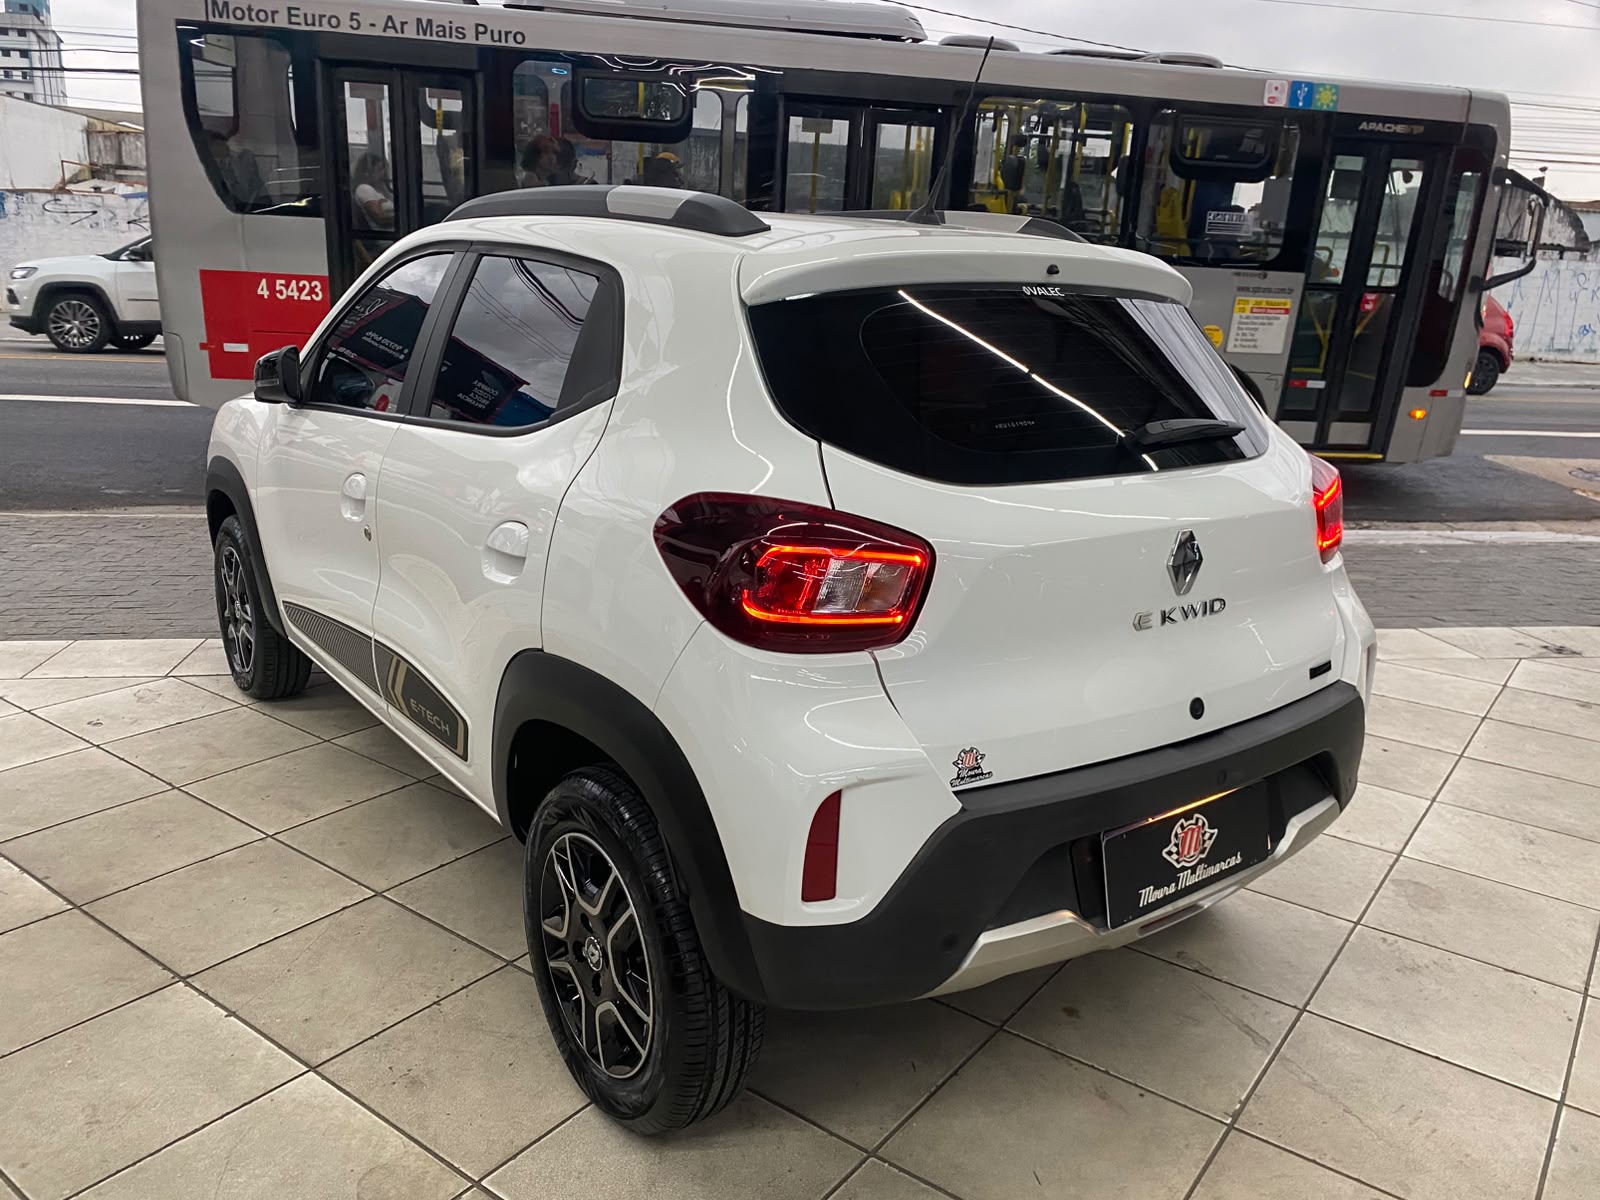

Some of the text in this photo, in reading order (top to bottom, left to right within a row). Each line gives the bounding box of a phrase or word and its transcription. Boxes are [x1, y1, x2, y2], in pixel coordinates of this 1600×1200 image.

[211, 0, 279, 24] Motor
[286, 6, 341, 29] Euro
[349, 12, 361, 31] 5
[382, 14, 408, 35] Ar
[415, 17, 467, 40] Mais
[474, 22, 526, 45] Puro
[257, 278, 323, 301] 4 5423
[1160, 597, 1226, 627] KWID
[410, 698, 450, 736] E-TECH
[1138, 851, 1242, 908] Moura Multimarcas
